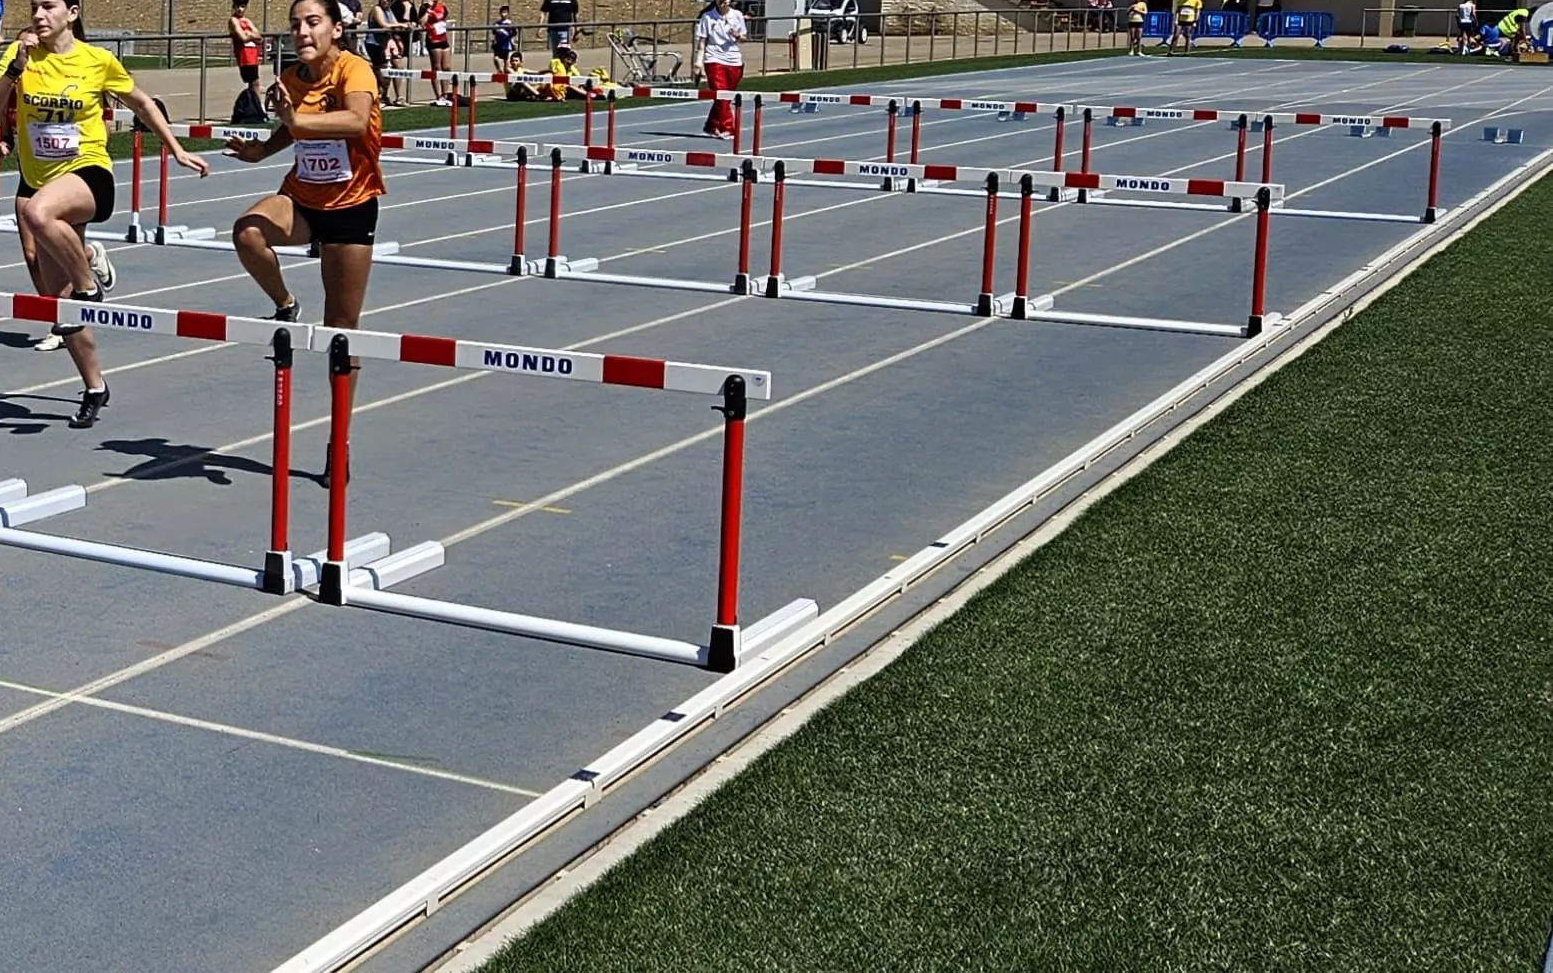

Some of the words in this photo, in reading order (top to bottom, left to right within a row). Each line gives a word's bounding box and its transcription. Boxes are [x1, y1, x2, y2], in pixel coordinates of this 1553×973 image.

[22, 94, 84, 110] SCORPIO
[971, 102, 1005, 110] MONDO
[1146, 110, 1182, 118] MONDO
[1332, 117, 1371, 125] MONDO
[35, 136, 70, 150] 1507
[415, 140, 455, 150] MONDO
[628, 152, 672, 163] MONDO
[301, 157, 341, 172] 1702
[859, 165, 908, 176] MONDO
[1116, 178, 1170, 191] MONDO
[80, 307, 153, 330] MONDO
[483, 349, 573, 375] MONDO
